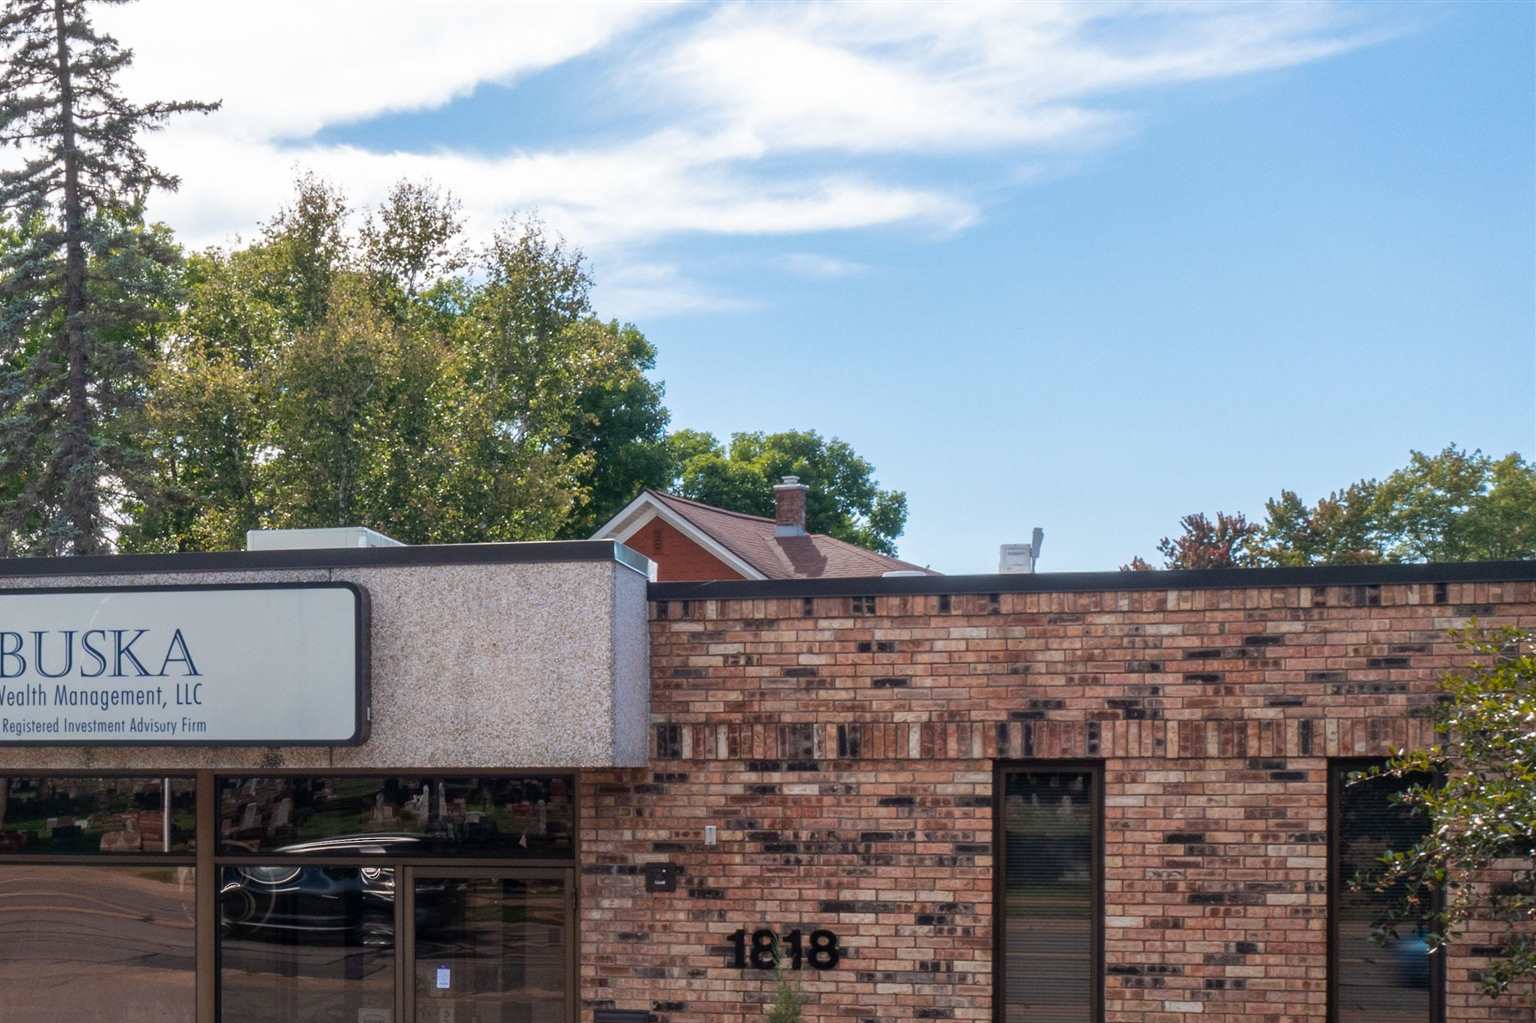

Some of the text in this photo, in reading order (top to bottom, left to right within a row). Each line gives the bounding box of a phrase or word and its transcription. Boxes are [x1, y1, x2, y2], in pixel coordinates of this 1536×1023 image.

[54, 684, 168, 711] Management,
[175, 683, 203, 705] LLC
[2, 717, 60, 736] Registered
[64, 717, 125, 733] Investment
[129, 716, 177, 735] Advisory
[182, 716, 207, 733] Firm
[726, 929, 840, 970] 1818
